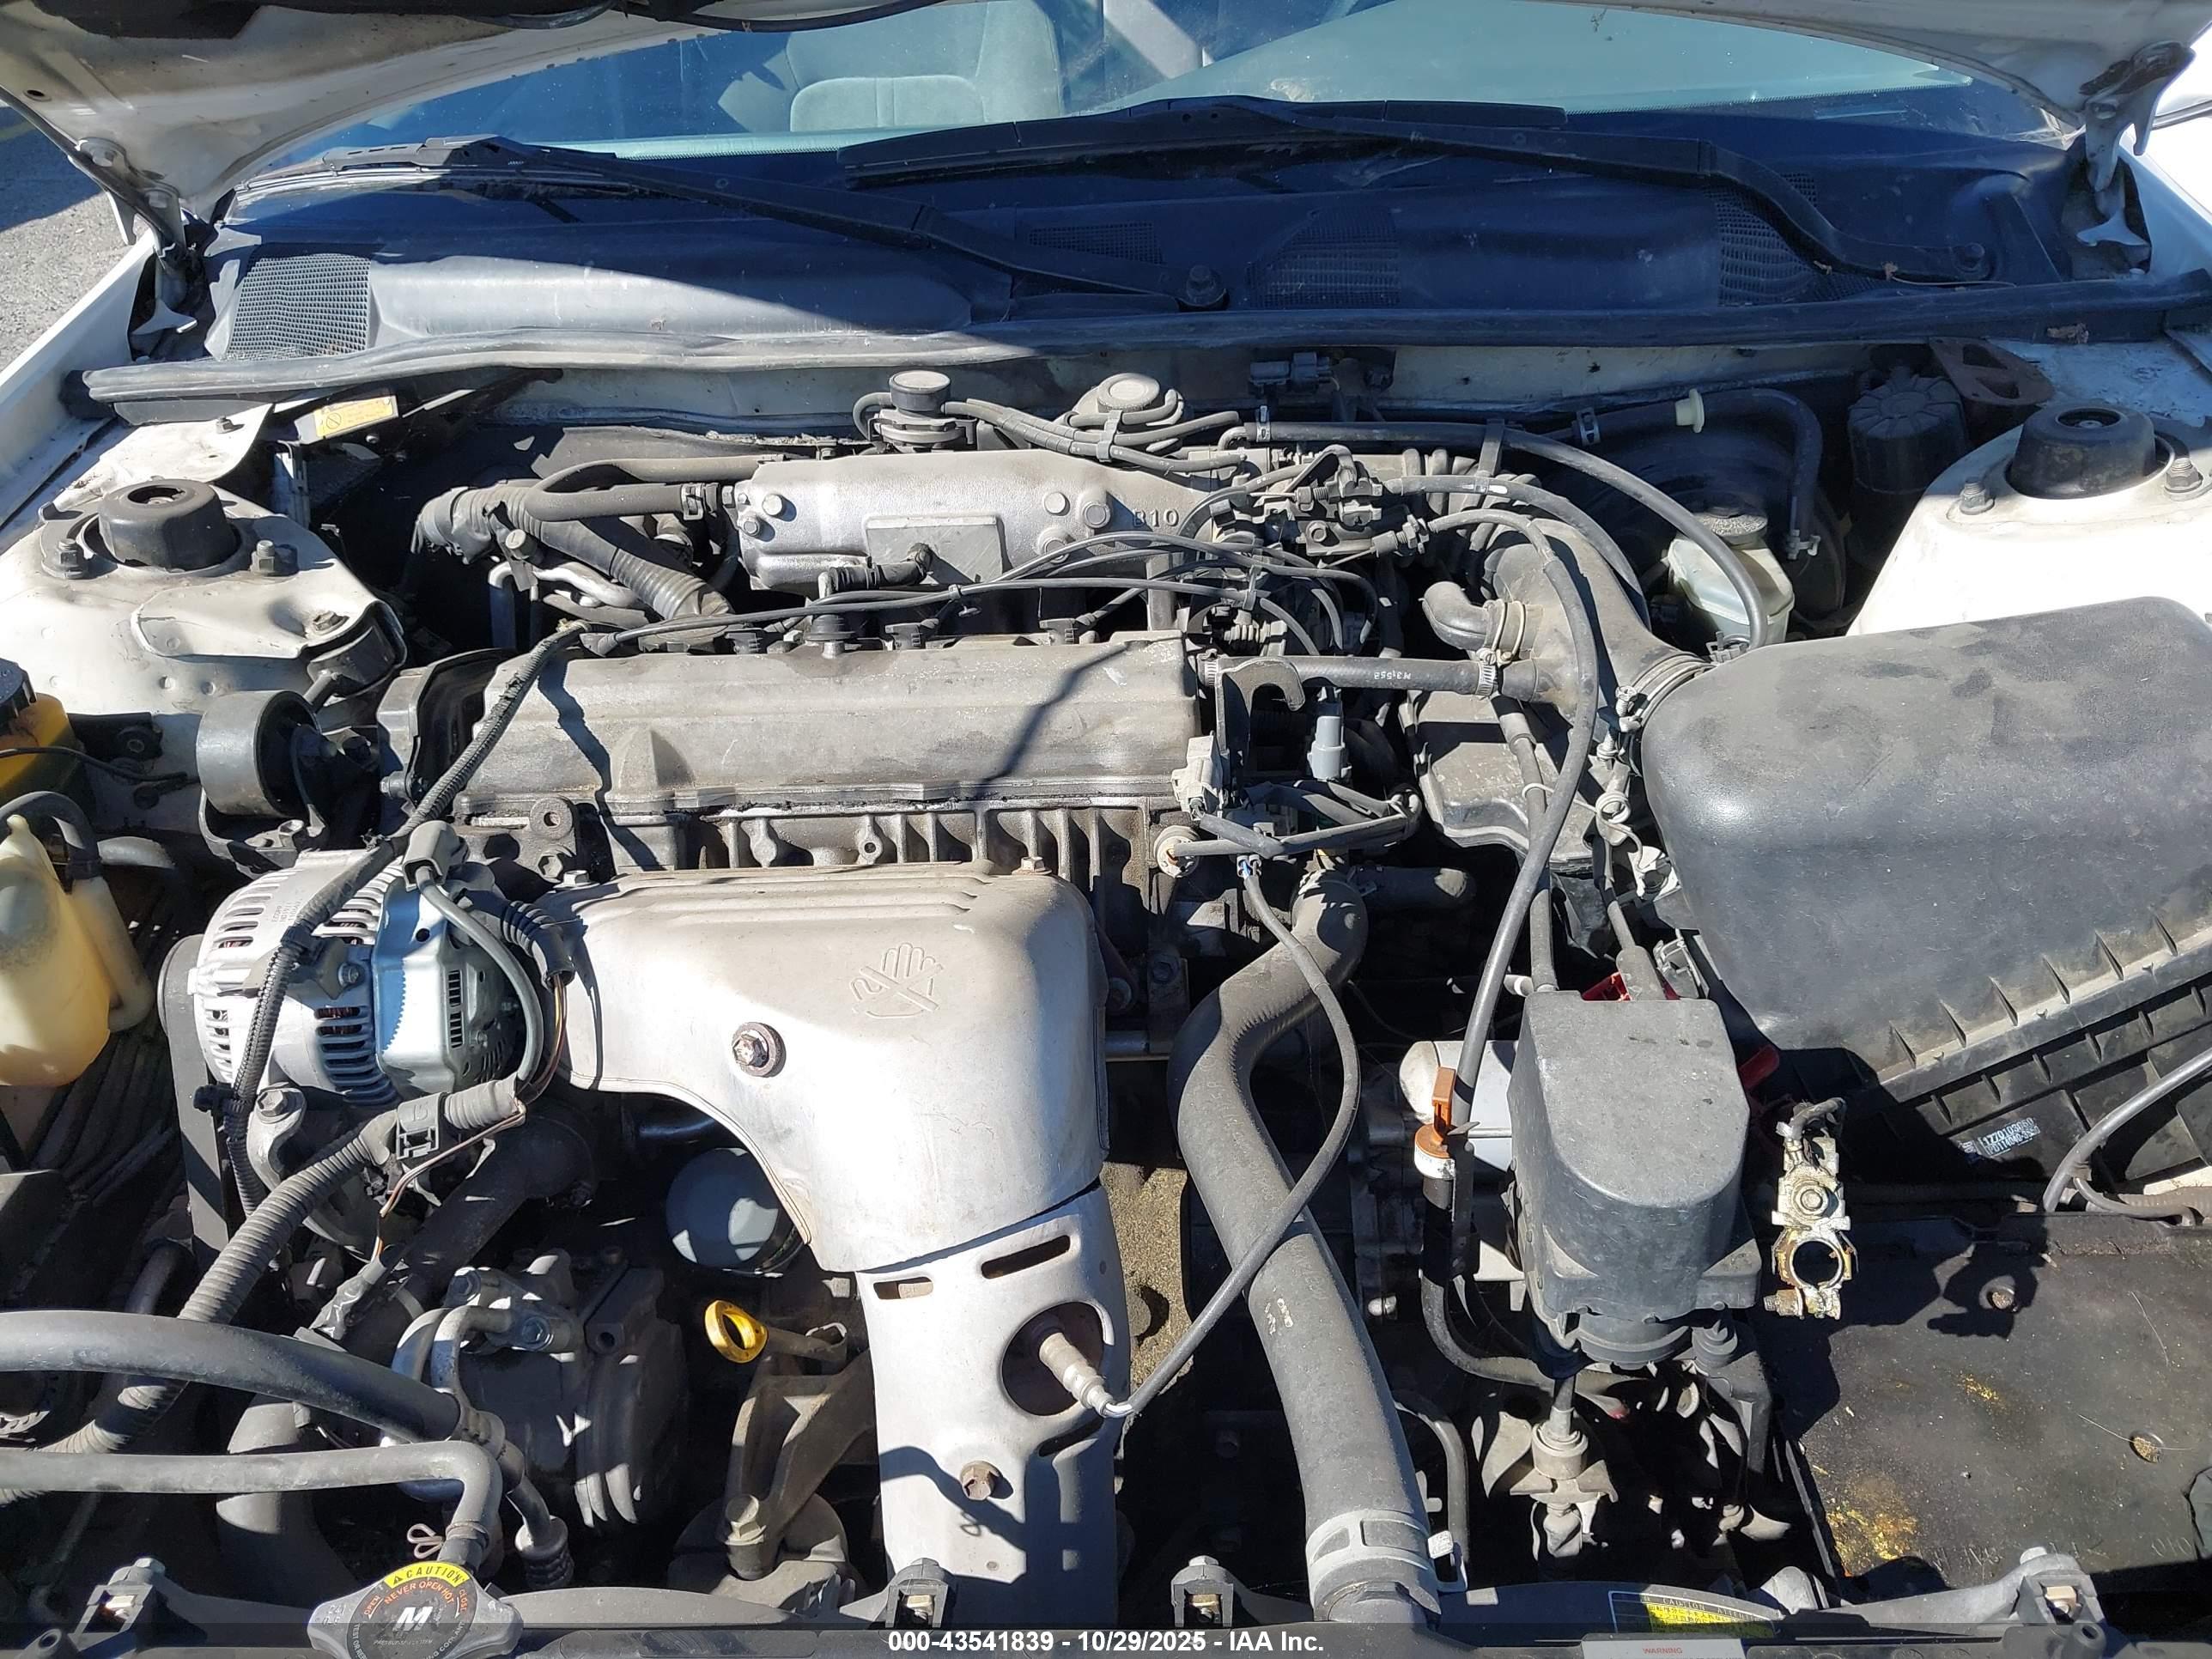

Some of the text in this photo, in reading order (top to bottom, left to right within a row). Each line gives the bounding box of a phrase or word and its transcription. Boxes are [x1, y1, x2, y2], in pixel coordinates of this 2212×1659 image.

[406, 1565, 462, 1583] CAUTION
[384, 1580, 454, 1605] NEVER OPEN HOT
[363, 1595, 380, 1615] OPEN
[1662, 1597, 1705, 1611] CAUTION
[392, 1606, 433, 1632] M
[352, 1623, 361, 1639] TEST
[353, 1640, 361, 1650] OR
